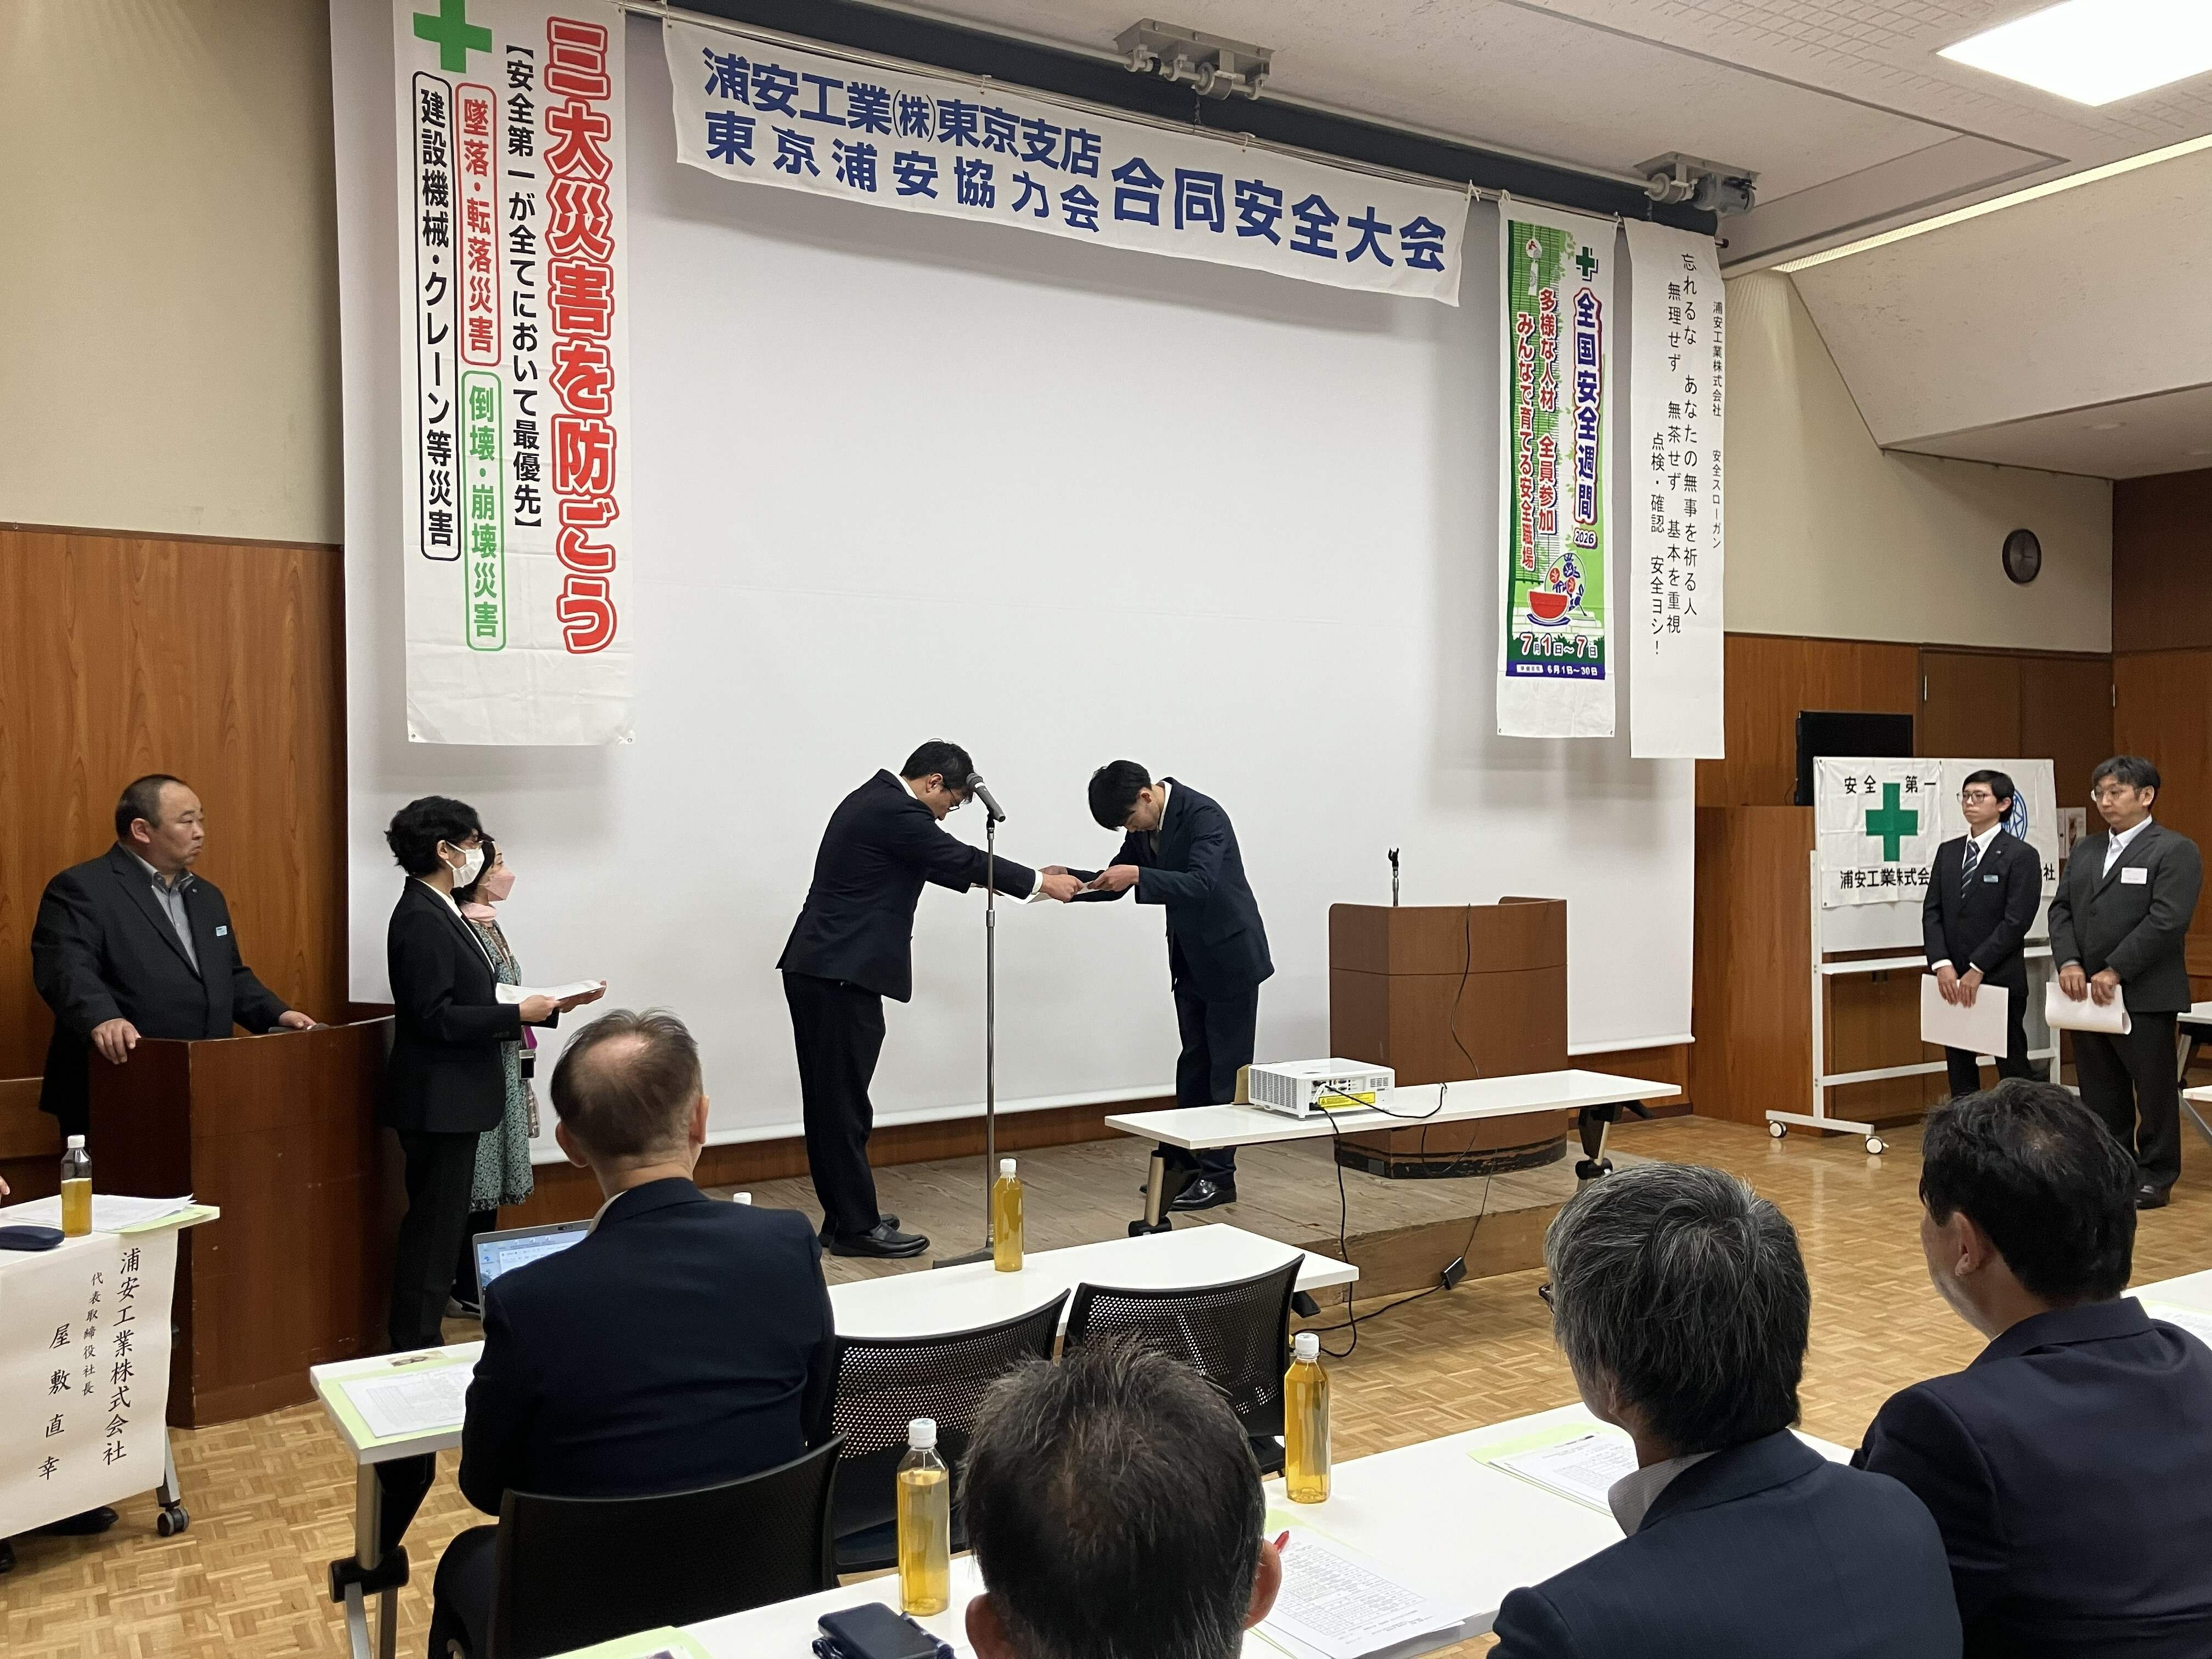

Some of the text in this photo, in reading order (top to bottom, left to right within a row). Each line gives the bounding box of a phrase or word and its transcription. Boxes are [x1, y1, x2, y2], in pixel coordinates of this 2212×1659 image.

[463, 99, 493, 353] 墜落・転落災害
[505, 44, 541, 527] 【安全第一が全てにおいて最優先】
[704, 110, 1099, 233] 東京浦安協力会
[1111, 156, 1446, 272] 合同安全大会
[421, 88, 453, 546] 建設機械・クレーン等災害
[544, 16, 620, 654] 三大災害を防ごう
[1539, 289, 1556, 532] 多様な人材 全員参加
[1577, 293, 1599, 520] 全国安全週間
[1681, 253, 1697, 616] 忘れるな あなたの無事を祈る人
[1712, 301, 1723, 549] 浦安工業株式会社 安全スローガン
[469, 385, 499, 637] 倒壊・崩壊災害
[1517, 313, 1534, 569] みんなで育てる安全職場
[1575, 531, 1594, 544] 2026
[1650, 431, 1665, 533] 点検・確認
[1667, 281, 1681, 634] 無理せず 無茶せず 基本を重視
[2042, 863, 2056, 881] 社
[82, 1272, 104, 1397] 代表取締役社長
[102, 1247, 142, 1466] 浦安工業株式会社
